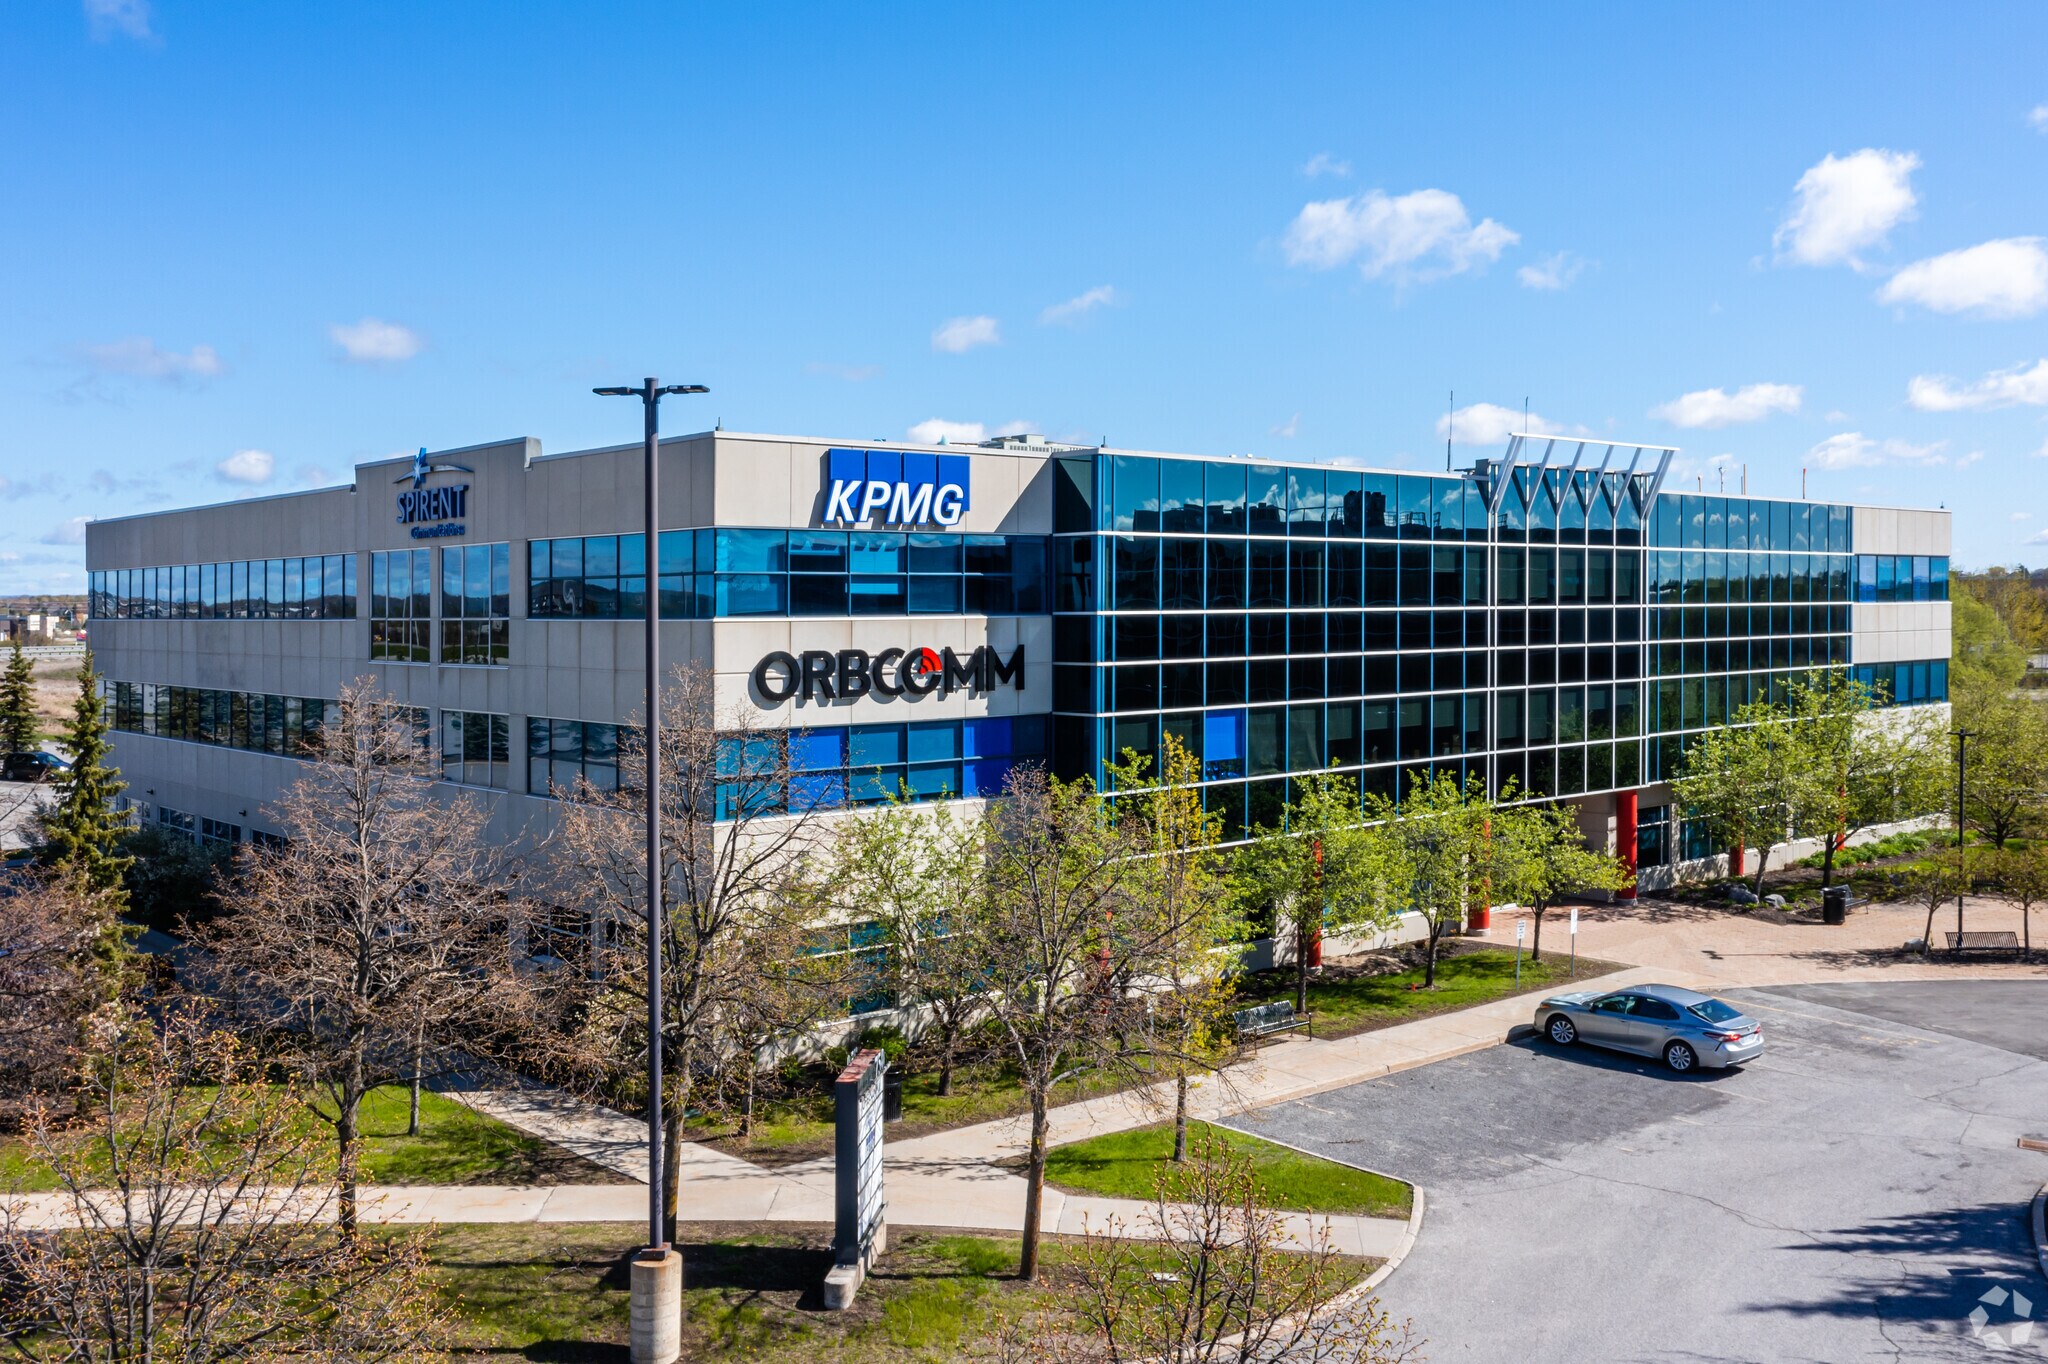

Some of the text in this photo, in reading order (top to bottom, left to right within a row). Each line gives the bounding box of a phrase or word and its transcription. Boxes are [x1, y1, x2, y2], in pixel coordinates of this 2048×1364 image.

[396, 485, 468, 524] SPIRENT
[824, 478, 965, 527] KPMG
[755, 644, 1025, 701] ORBCOMM
